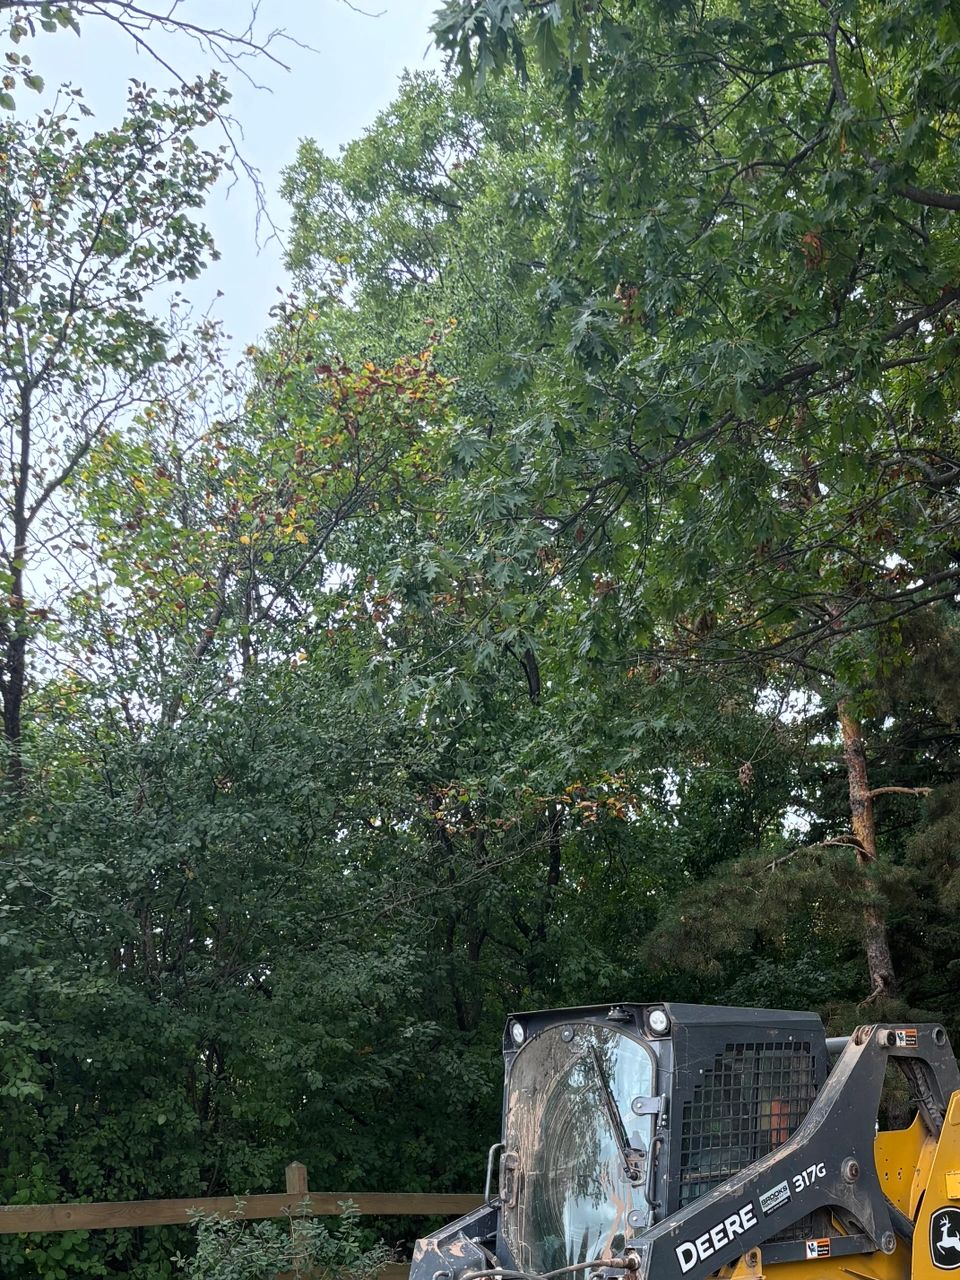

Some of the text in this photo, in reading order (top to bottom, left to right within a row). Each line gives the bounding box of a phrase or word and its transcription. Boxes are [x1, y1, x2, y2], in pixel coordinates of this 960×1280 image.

[792, 1162, 827, 1193] 317G
[761, 1184, 788, 1206] BROOKS
[675, 1203, 758, 1274] DEERE
